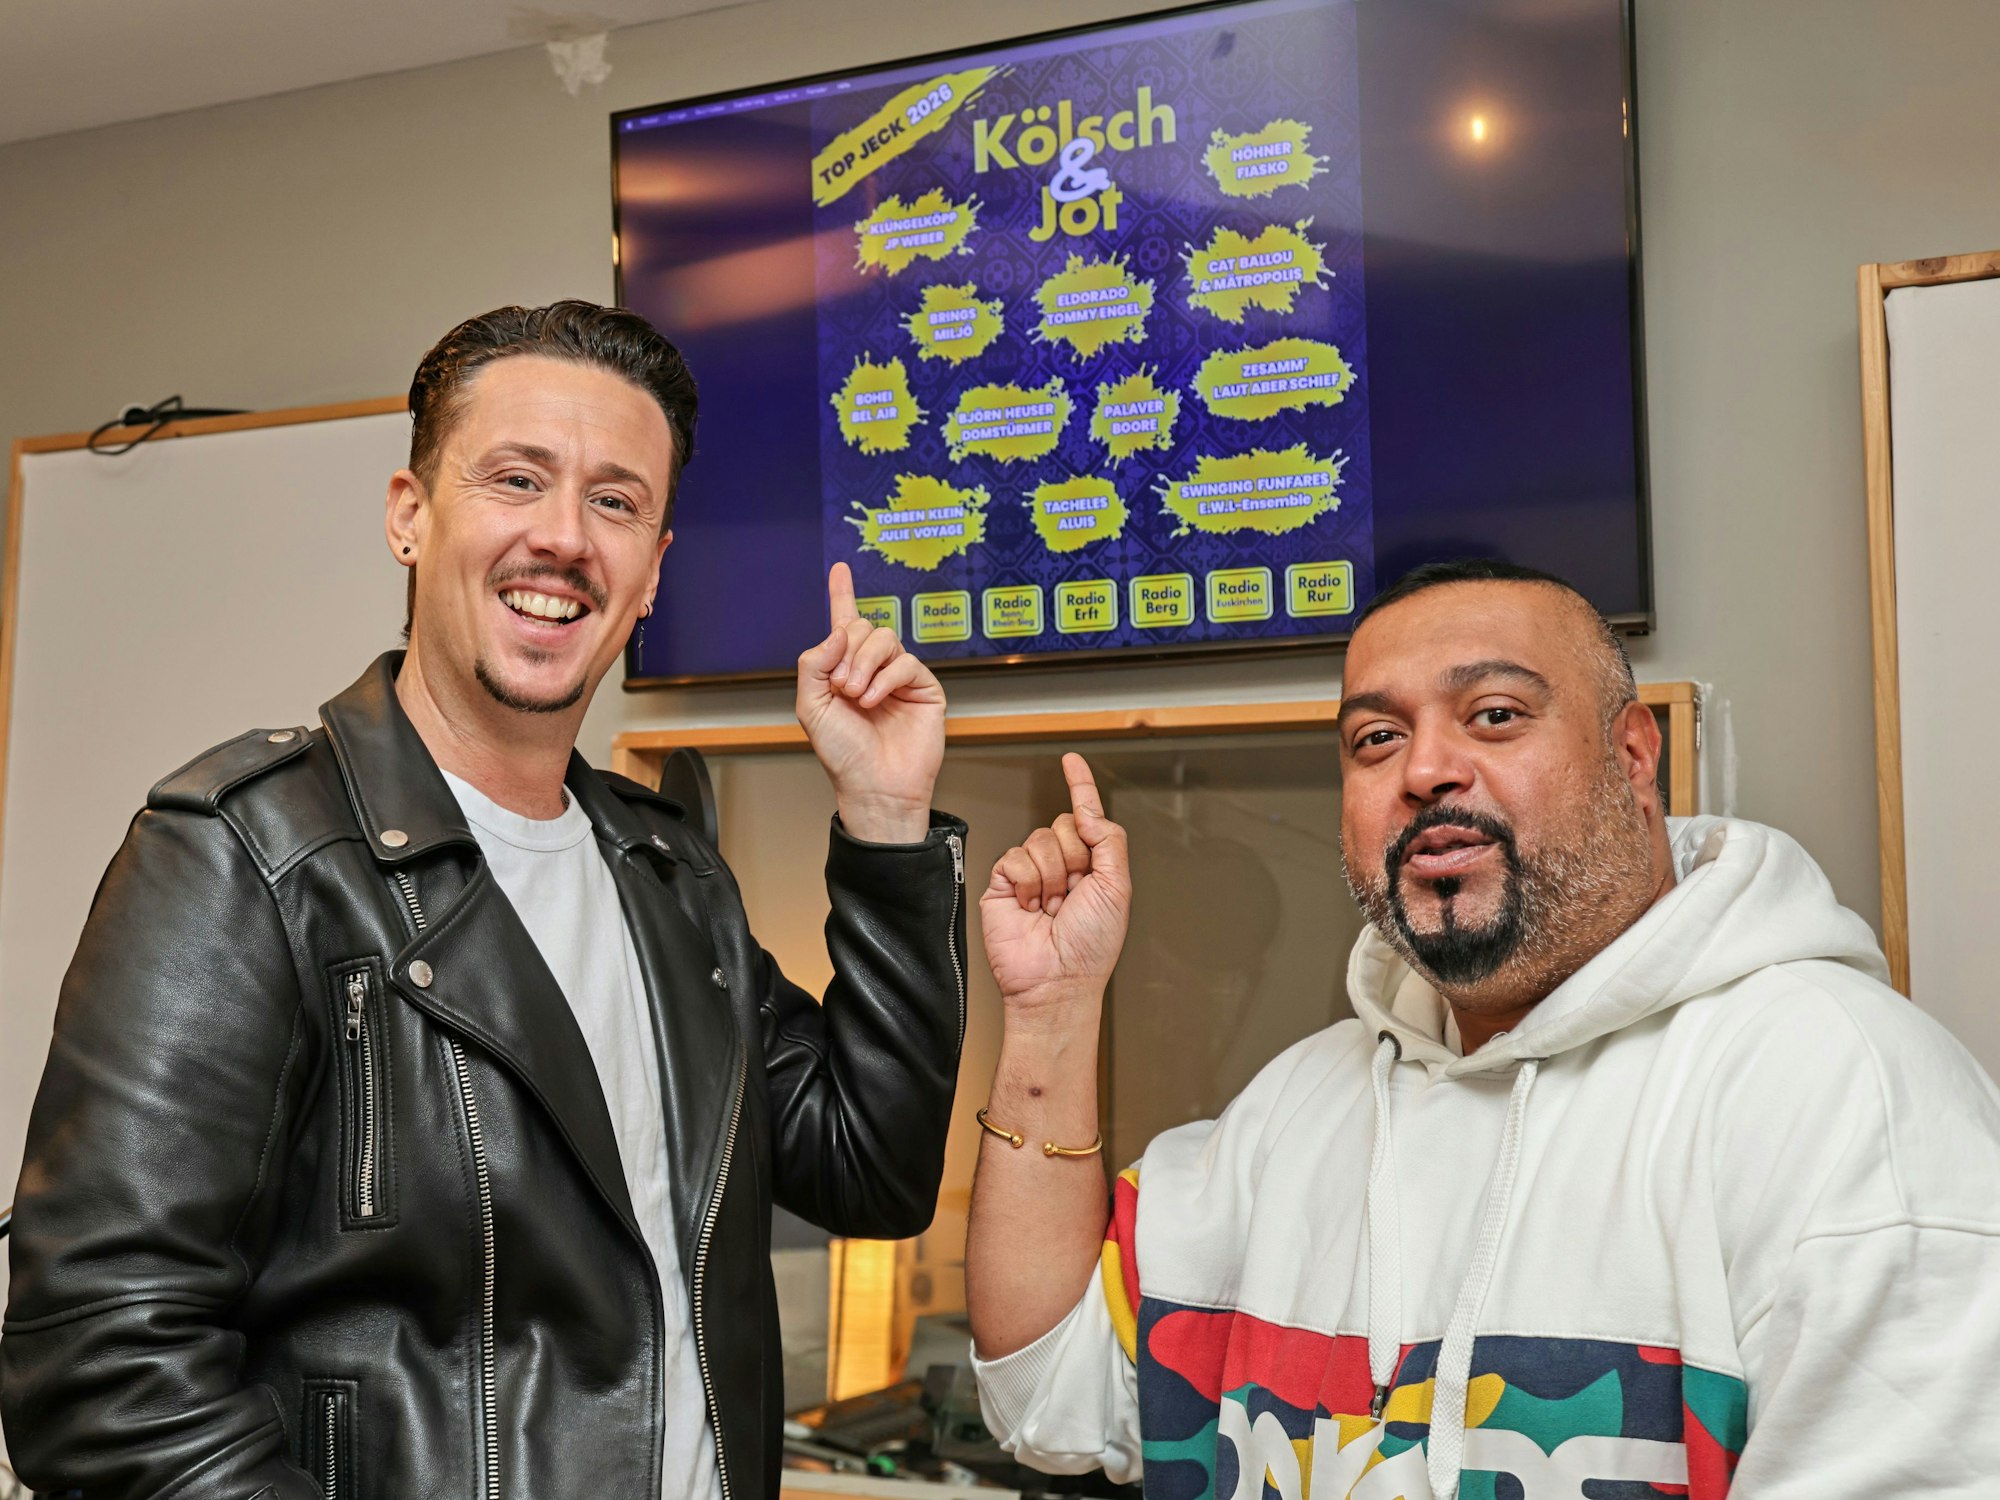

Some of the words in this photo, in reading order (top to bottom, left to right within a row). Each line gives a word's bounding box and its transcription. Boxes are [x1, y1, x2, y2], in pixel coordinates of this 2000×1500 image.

[819, 151, 856, 185] TOP
[859, 118, 905, 160] JECK
[906, 83, 953, 126] 2026
[973, 86, 1176, 173] Kölsch
[1232, 141, 1292, 162] HÖHNER
[1049, 136, 1111, 203] &
[1236, 160, 1289, 179] FIASKO
[1028, 178, 1123, 242] Jot
[869, 210, 958, 235] KLÜNGELKÖPP
[884, 237, 900, 251] JP
[900, 231, 945, 248] WEBER
[1208, 258, 1236, 273] CAT
[1239, 250, 1293, 269] BALLOU
[1200, 280, 1211, 293] &
[1213, 267, 1303, 290] MÄTROPOLIS
[1057, 286, 1129, 307] ELDORADO
[929, 307, 977, 326] BRINGS
[1046, 307, 1097, 326] TOMMY
[1099, 302, 1141, 319] ENGEL
[934, 321, 973, 341] MILJÖ
[1242, 357, 1308, 377] ZESAMM'
[1213, 383, 1249, 400] LAUT
[1251, 379, 1290, 395] ABER
[1290, 373, 1341, 390] SCHIEF
[855, 390, 894, 406] BOHEI
[851, 409, 872, 423] BEL
[875, 406, 898, 420] AIR
[958, 408, 1002, 425] BJÖRN
[1004, 402, 1055, 419] HEUSER
[1103, 399, 1164, 418] PALAVER
[961, 420, 1053, 442] DOMSTÜRMER
[1111, 418, 1158, 435] BOORE
[1180, 480, 1254, 499] SWINGING
[1256, 472, 1330, 491] FUNFARES
[1044, 496, 1109, 514] TACHELES
[876, 509, 925, 525] TORBEN
[927, 506, 965, 520] KLEIN
[1057, 515, 1096, 530] ALUIS
[878, 528, 910, 542] JULIE
[912, 523, 964, 539] VOYAGE
[1218, 580, 1260, 595] Radio
[1298, 574, 1341, 589] Radio
[994, 595, 1032, 609] Radio
[1066, 592, 1106, 606] Radio
[1141, 586, 1181, 600] Radio
[1308, 590, 1333, 603] Rur
[923, 603, 960, 617] Radio
[1074, 606, 1099, 621] Erft
[1146, 602, 1178, 616] Berg
